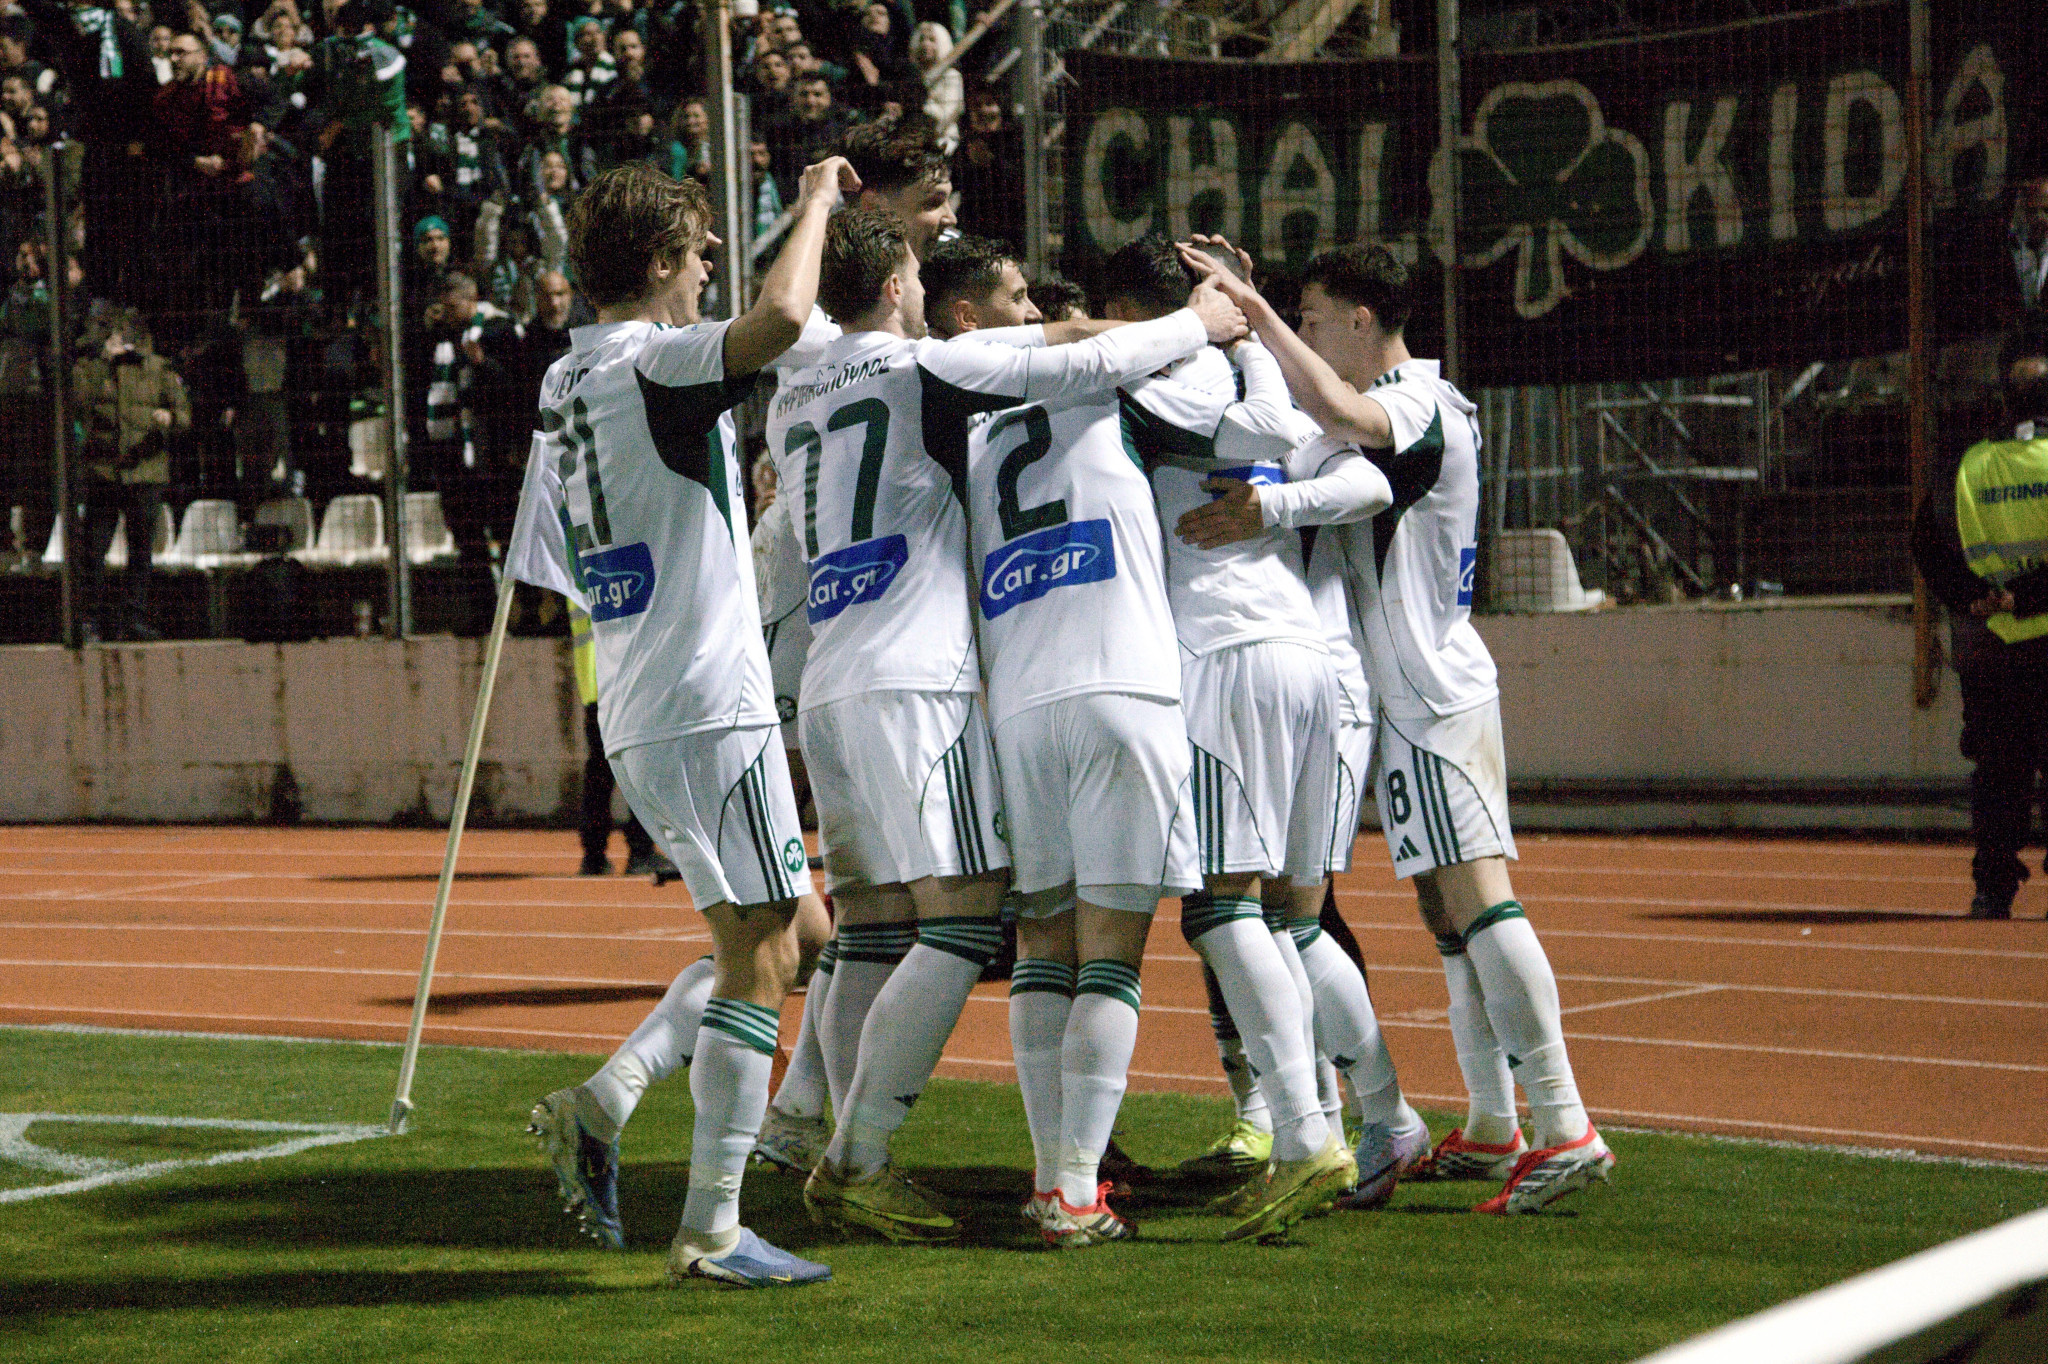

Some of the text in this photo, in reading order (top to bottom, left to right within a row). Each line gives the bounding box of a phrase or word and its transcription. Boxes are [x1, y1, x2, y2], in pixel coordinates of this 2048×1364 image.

[1665, 44, 2007, 253] KIDA
[785, 397, 891, 559] 77
[986, 405, 1068, 542] 2
[987, 547, 1088, 601] Car.gr
